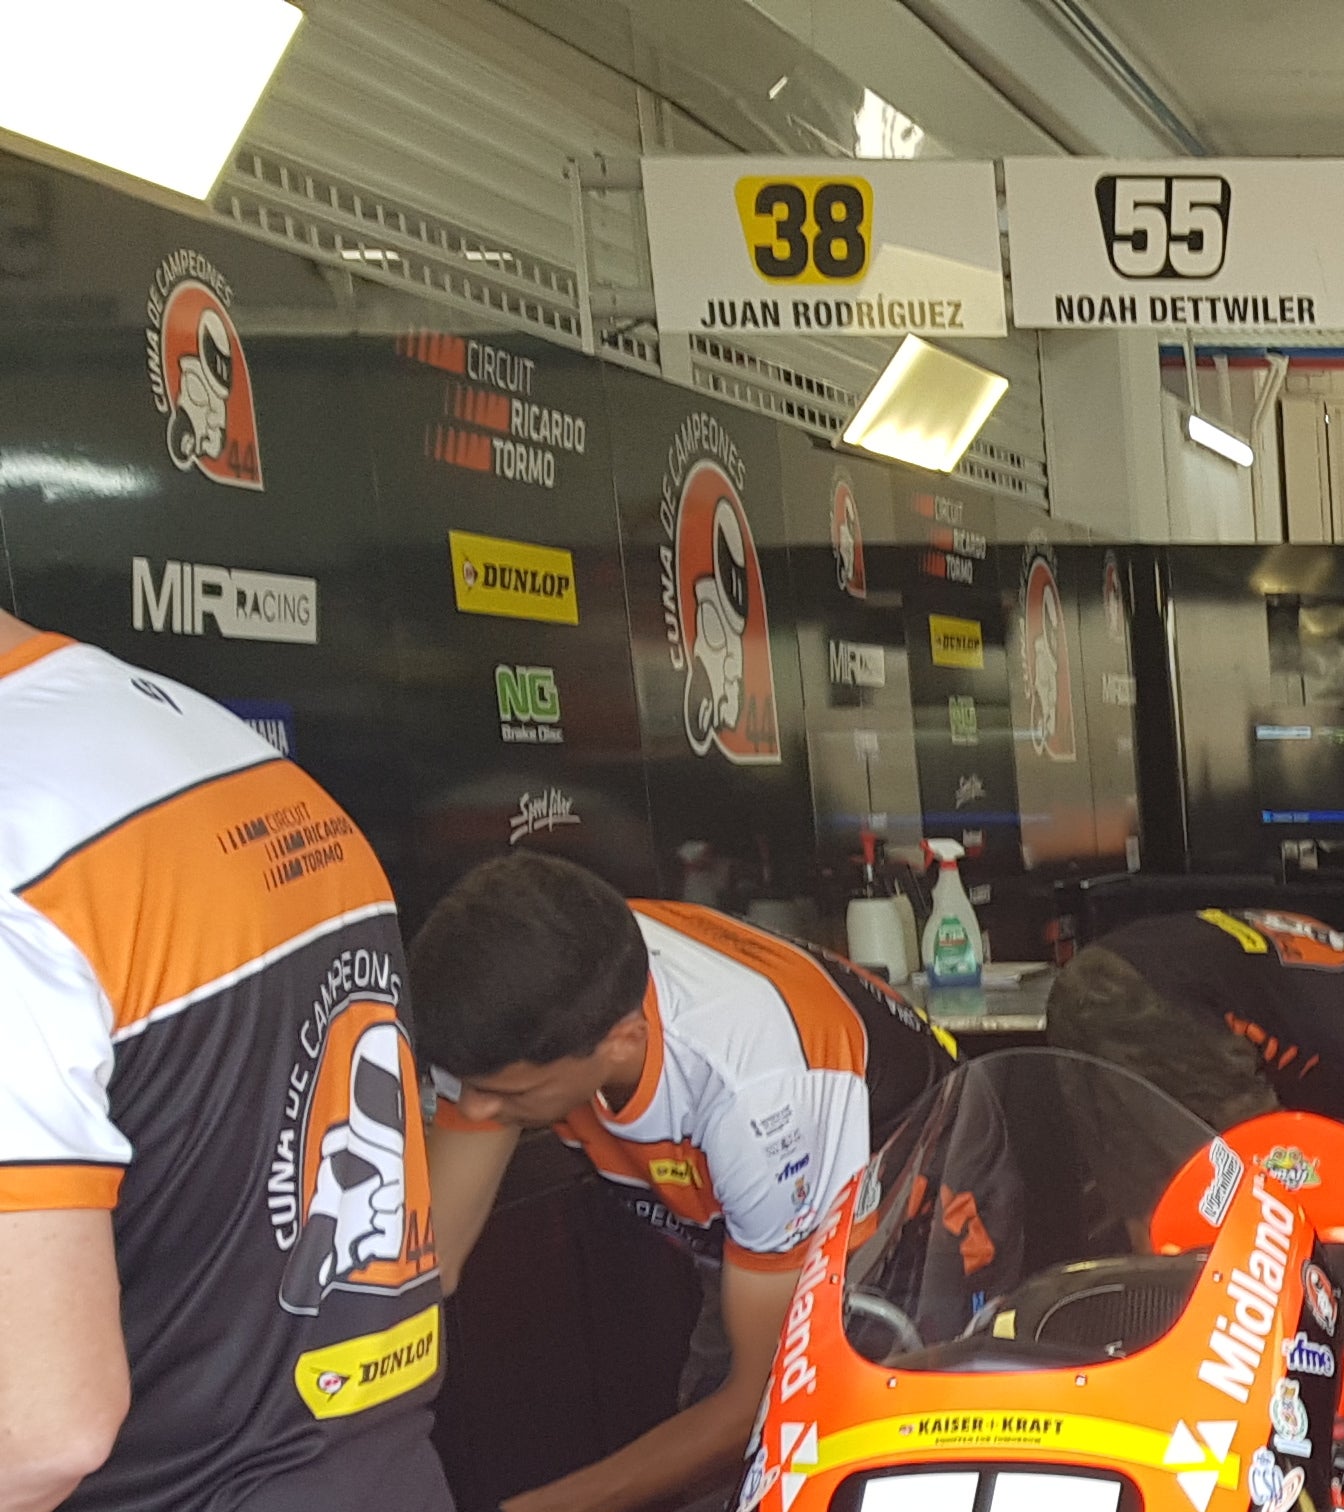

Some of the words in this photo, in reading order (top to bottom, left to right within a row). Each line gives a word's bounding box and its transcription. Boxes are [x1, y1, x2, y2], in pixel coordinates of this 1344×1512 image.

[753, 184, 866, 278] 38
[1113, 178, 1224, 277] 55
[147, 286, 163, 329] DE
[155, 249, 234, 308] CAMPEONES
[701, 299, 780, 329] JUAN
[793, 292, 963, 328] RODRÍGUEZ
[1055, 295, 1138, 324] NOAH
[1150, 295, 1315, 324] DETTWILER
[146, 328, 168, 413] CUNA
[465, 339, 535, 398] CIRCUIT
[510, 399, 586, 452] RICARDO
[669, 412, 746, 491] CAMPEONES
[492, 436, 556, 487] TORMO
[660, 476, 676, 541] DE
[133, 556, 232, 636] MIR
[236, 586, 311, 627] RACING
[482, 570, 571, 600] DUNLOP
[660, 545, 684, 671] CUNA
[496, 664, 561, 723] NG
[265, 801, 312, 833] CIRCUIT
[302, 842, 345, 875] TORMO
[266, 1133, 299, 1252] CUNA
[1198, 1174, 1295, 1404] Midland
[357, 1331, 434, 1387] DUNLOP
[918, 1416, 984, 1436] KAISER
[1002, 1415, 1065, 1436] KRAFT
